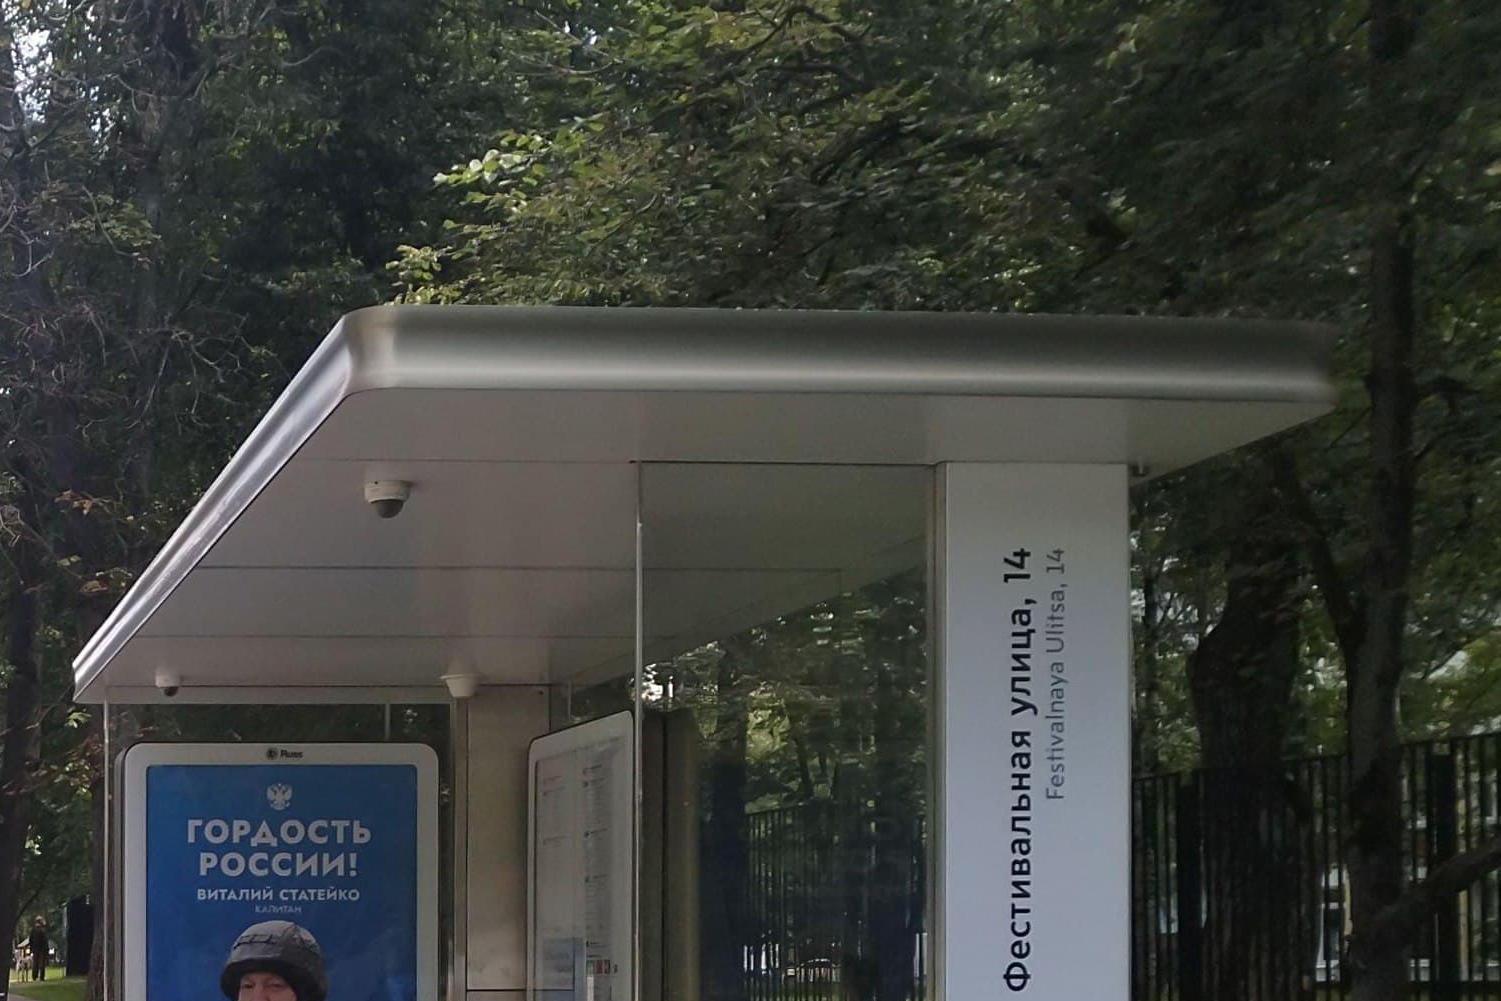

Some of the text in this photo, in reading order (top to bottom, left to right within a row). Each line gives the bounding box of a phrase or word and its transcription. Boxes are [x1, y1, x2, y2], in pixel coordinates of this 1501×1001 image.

[1044, 548, 1069, 801] Festivalnaya Ulitsa, 14
[1002, 547, 1038, 992] Фестивальная улица, 14
[187, 819, 371, 847] ГОРДОСТЬ
[199, 852, 357, 877] РОССИИ!
[197, 885, 360, 901] ВИТАЛИЙ СТАТЕЙКО
[255, 904, 302, 914] КАПИТАН
